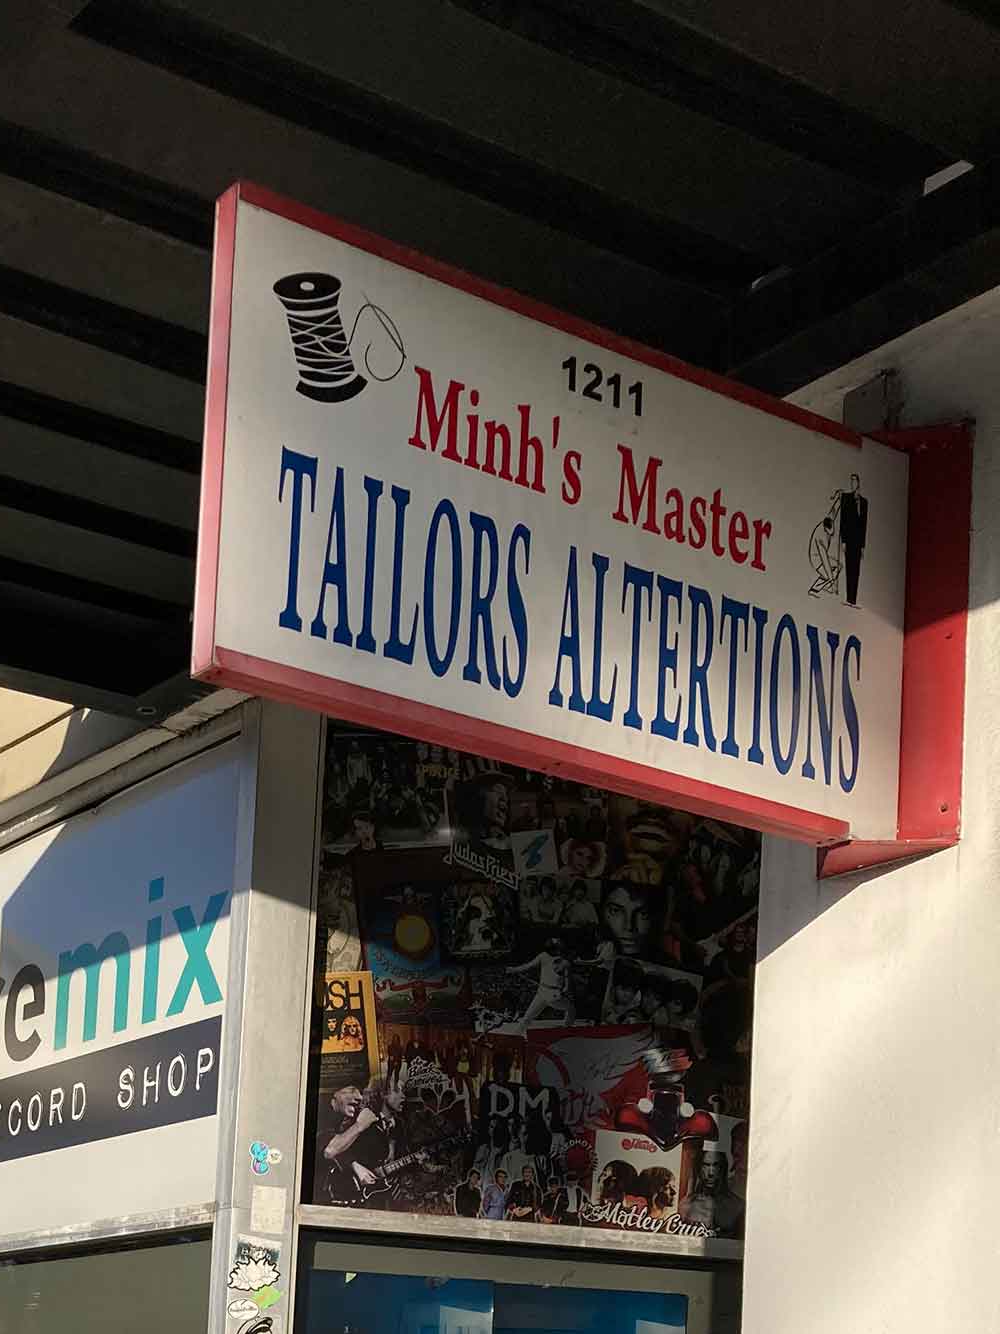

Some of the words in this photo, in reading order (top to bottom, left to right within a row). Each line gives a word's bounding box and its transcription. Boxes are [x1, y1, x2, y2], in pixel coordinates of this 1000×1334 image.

[560, 355, 644, 418] 1211
[409, 366, 583, 505] Minh's
[612, 445, 772, 572] Master
[278, 445, 532, 698] TAILORS
[548, 545, 862, 793] ALTERTIONS
[117, 1046, 215, 1110] SHOP
